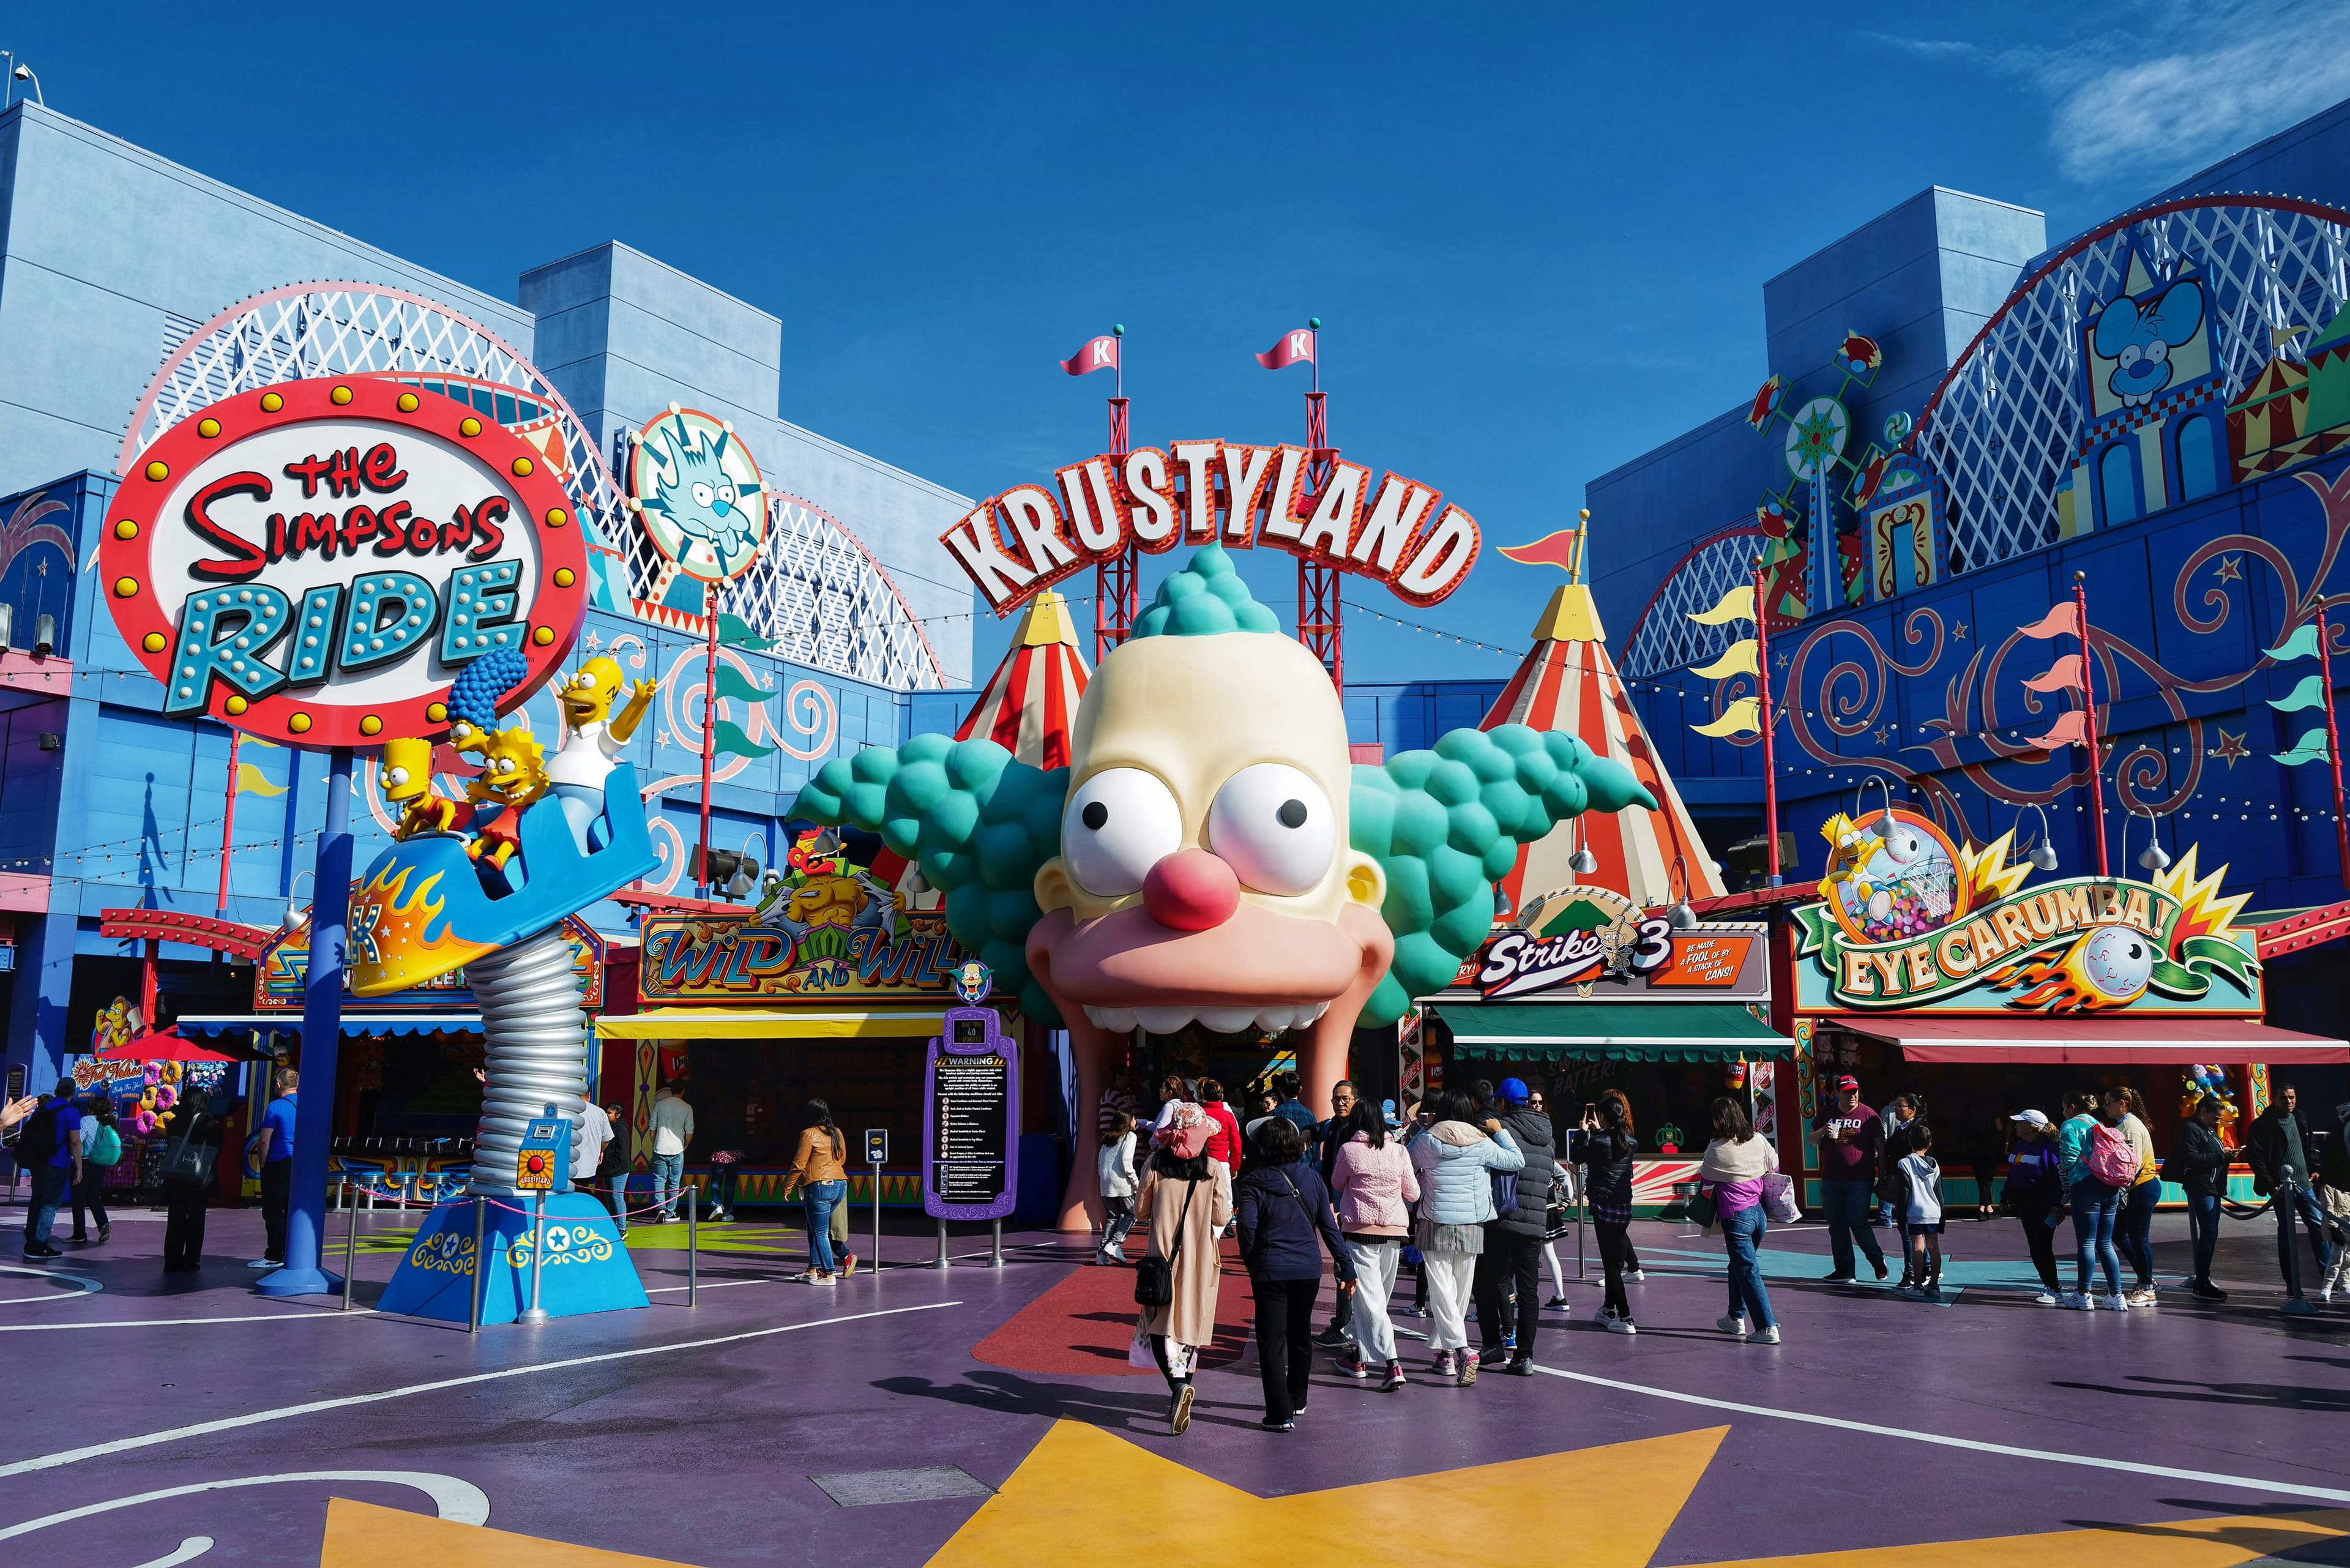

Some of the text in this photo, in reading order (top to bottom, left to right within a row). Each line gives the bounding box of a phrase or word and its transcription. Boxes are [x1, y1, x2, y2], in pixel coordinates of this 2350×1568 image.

[1092, 338, 1113, 365] K
[1290, 331, 1309, 359] K
[942, 441, 1479, 611] KRUSTYLAND
[163, 558, 531, 720] RIDE
[352, 905, 382, 965] K
[1842, 884, 2177, 996] EYE CARUMBA!
[1480, 918, 1672, 983] Strike 3
[1687, 940, 1715, 953] BE MADE
[1687, 950, 1709, 965] FOOL
[1712, 951, 1721, 960] OF
[1721, 949, 1731, 957] BY
[803, 961, 849, 989] AND
[846, 927, 977, 990] WILL
[1693, 962, 1714, 973] STACK
[1714, 959, 1723, 968] OF
[1459, 963, 1476, 976] RY!
[1705, 965, 1734, 982] CANS!
[83, 1064, 108, 1088] Full
[108, 1059, 143, 1080] Nelson
[1403, 1067, 1416, 1086] STRIKE
[1754, 1066, 1767, 1086] STRIKE
[1756, 1109, 1769, 1130] STRIKE
[1828, 1118, 1861, 1129] AERO
[521, 1176, 551, 1185] KRUSTYLAND
